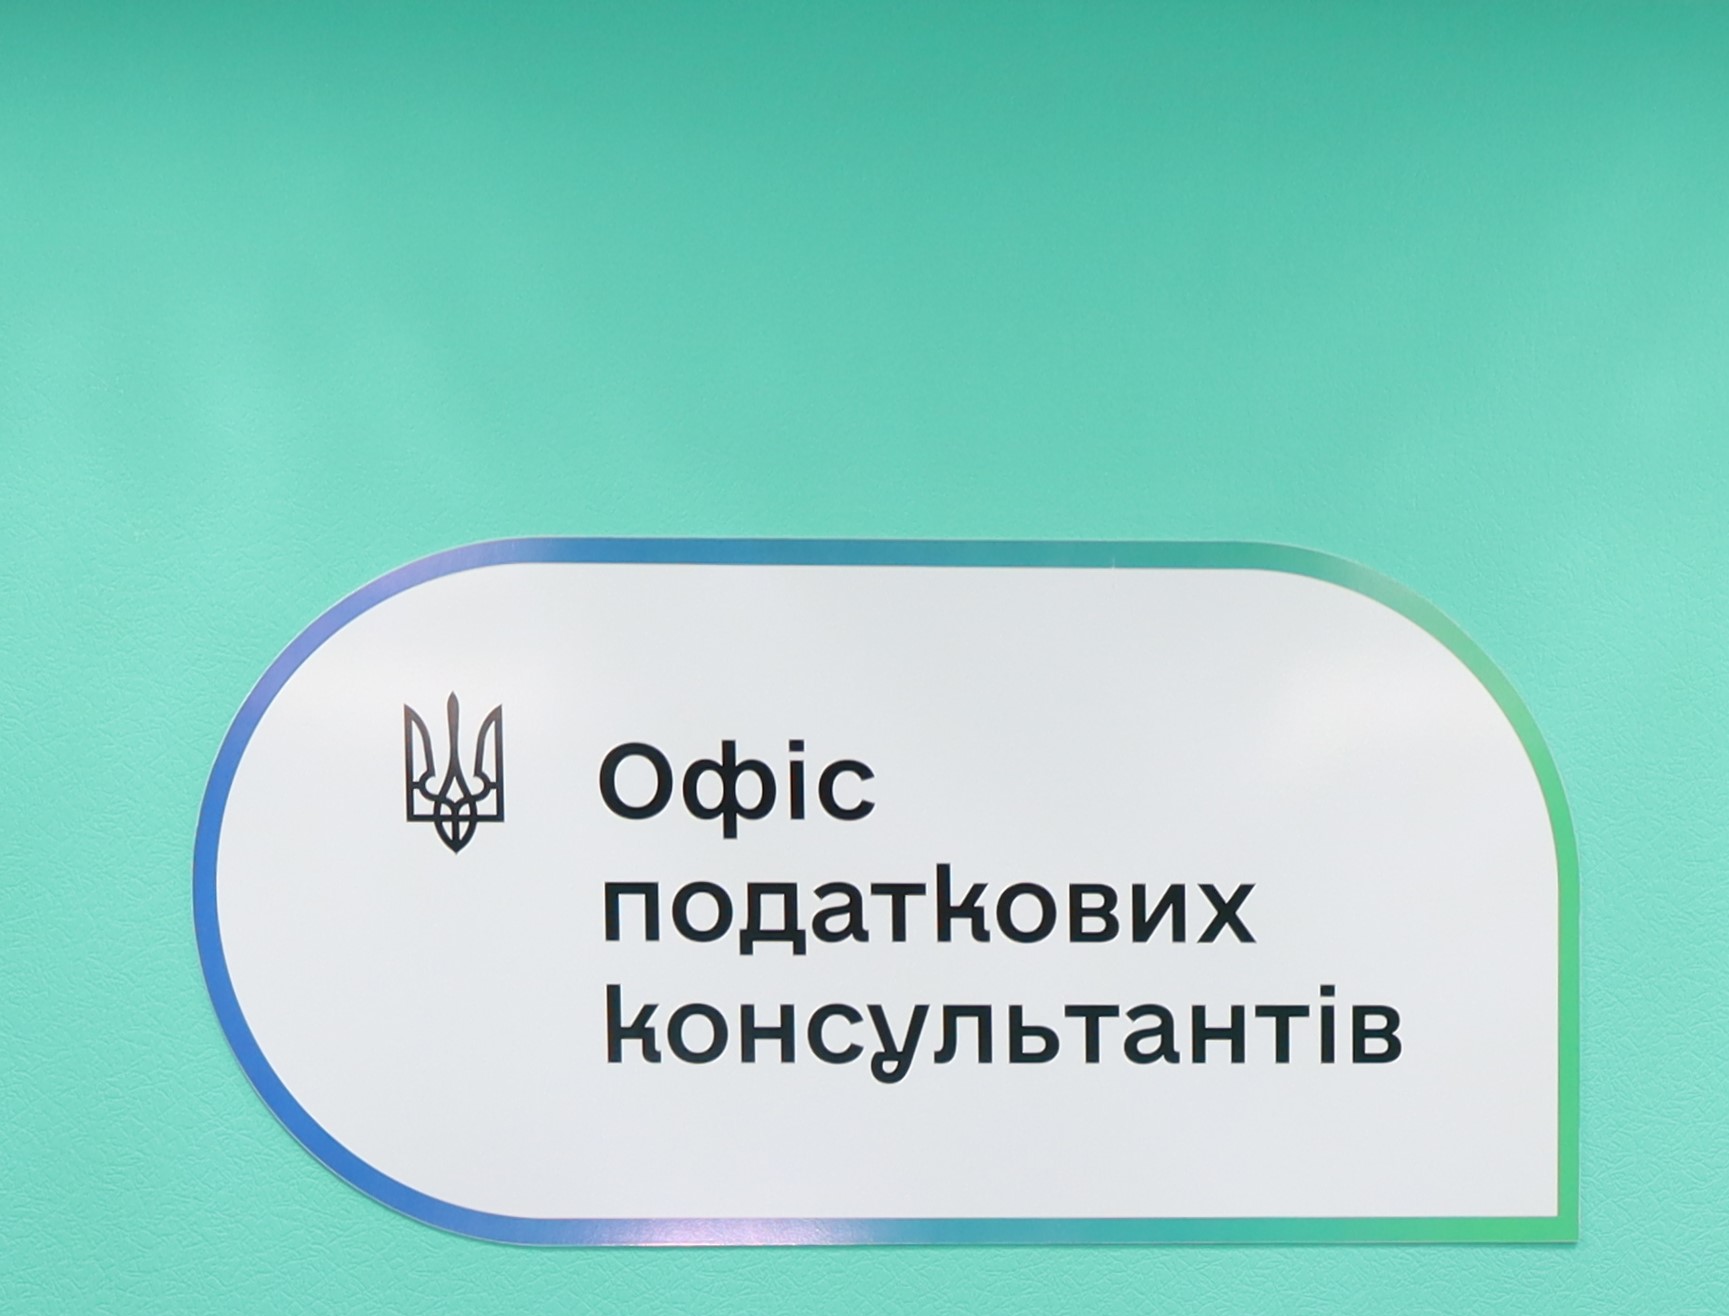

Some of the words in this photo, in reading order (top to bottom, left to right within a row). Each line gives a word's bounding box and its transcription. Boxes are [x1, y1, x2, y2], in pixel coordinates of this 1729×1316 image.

[599, 739, 875, 839] Офіс
[604, 863, 1256, 957] податкових
[606, 984, 1402, 1083] консультантів
